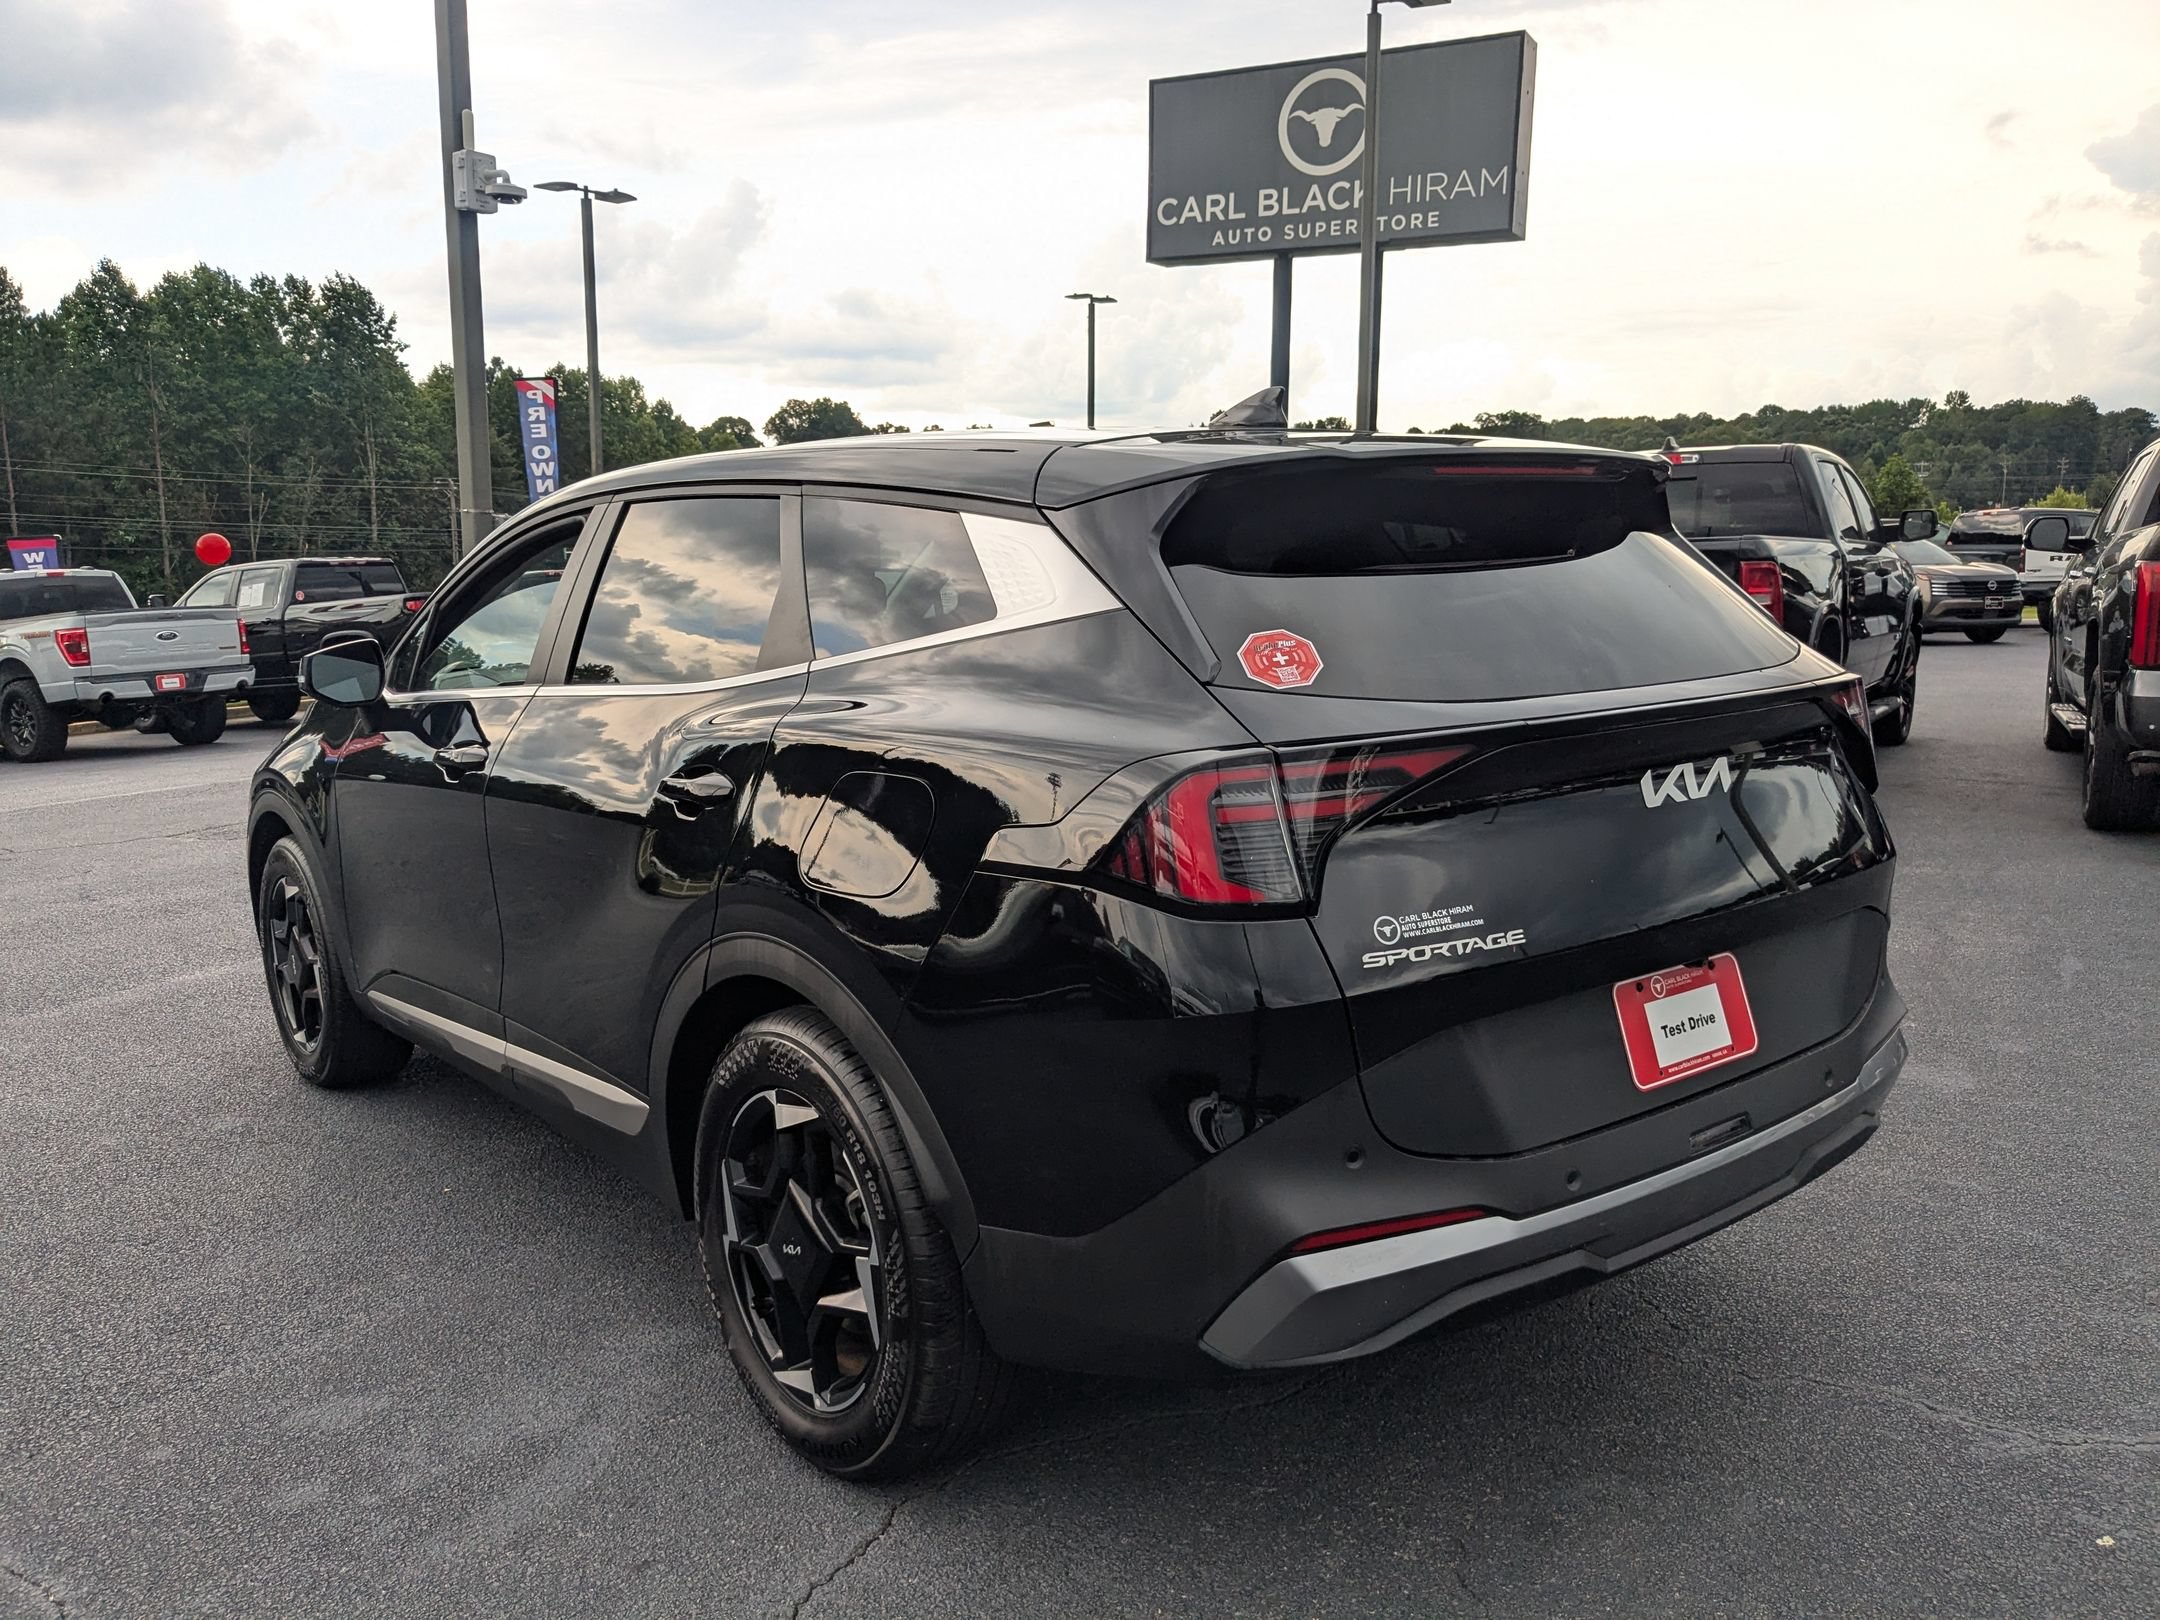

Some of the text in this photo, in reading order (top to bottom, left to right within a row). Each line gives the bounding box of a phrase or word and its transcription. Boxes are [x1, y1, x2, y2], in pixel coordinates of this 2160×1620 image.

[1156, 164, 1508, 226] CARL BLACK HIRAM
[1211, 211, 1440, 247] AUTO SUPERTORE
[1640, 756, 1732, 808] KIA
[1398, 904, 1474, 924] CARL BLACK HIRAM
[1401, 916, 1452, 931] AUTO SUPERSTORE
[1402, 918, 1485, 939] WWW.CARLBLACKHIRAM.COM
[1361, 928, 1527, 968] SPORTAGE
[1660, 1012, 1717, 1039] Test Drive
[845, 1128, 868, 1165] R18
[864, 1168, 887, 1221] 103H
[782, 1243, 801, 1256] KIA
